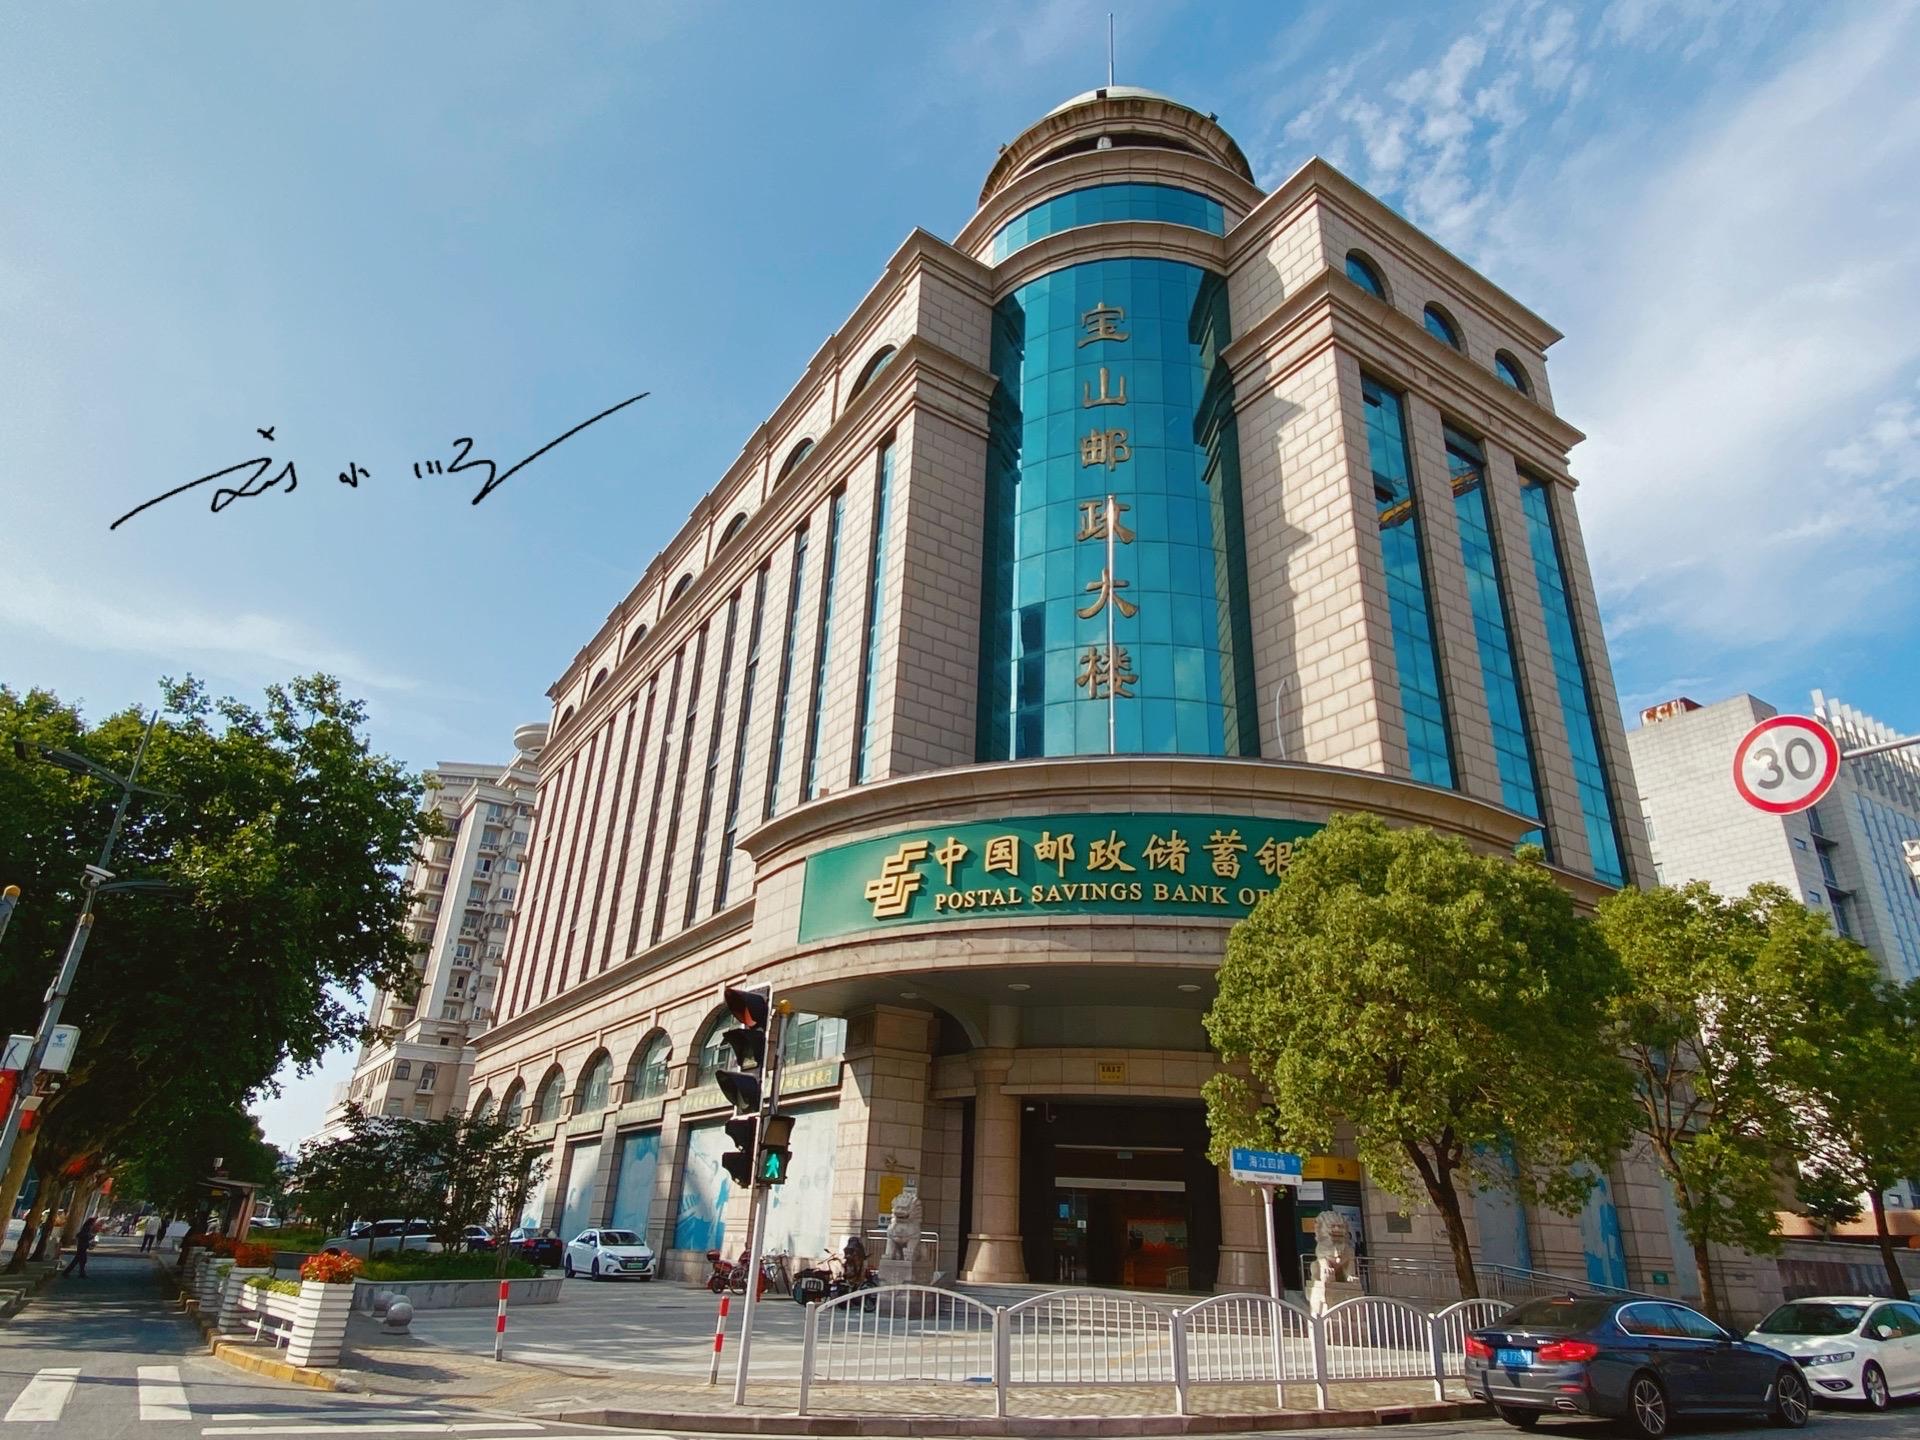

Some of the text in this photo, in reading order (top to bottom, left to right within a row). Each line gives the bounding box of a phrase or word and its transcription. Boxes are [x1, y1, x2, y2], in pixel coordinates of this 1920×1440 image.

[1076, 302, 1139, 699] 宝山邮政大楼
[1753, 737, 1817, 789] 30
[935, 887, 1022, 910] POSTAL
[1031, 883, 1142, 903] SAVINGS
[1153, 883, 1230, 904] BANK
